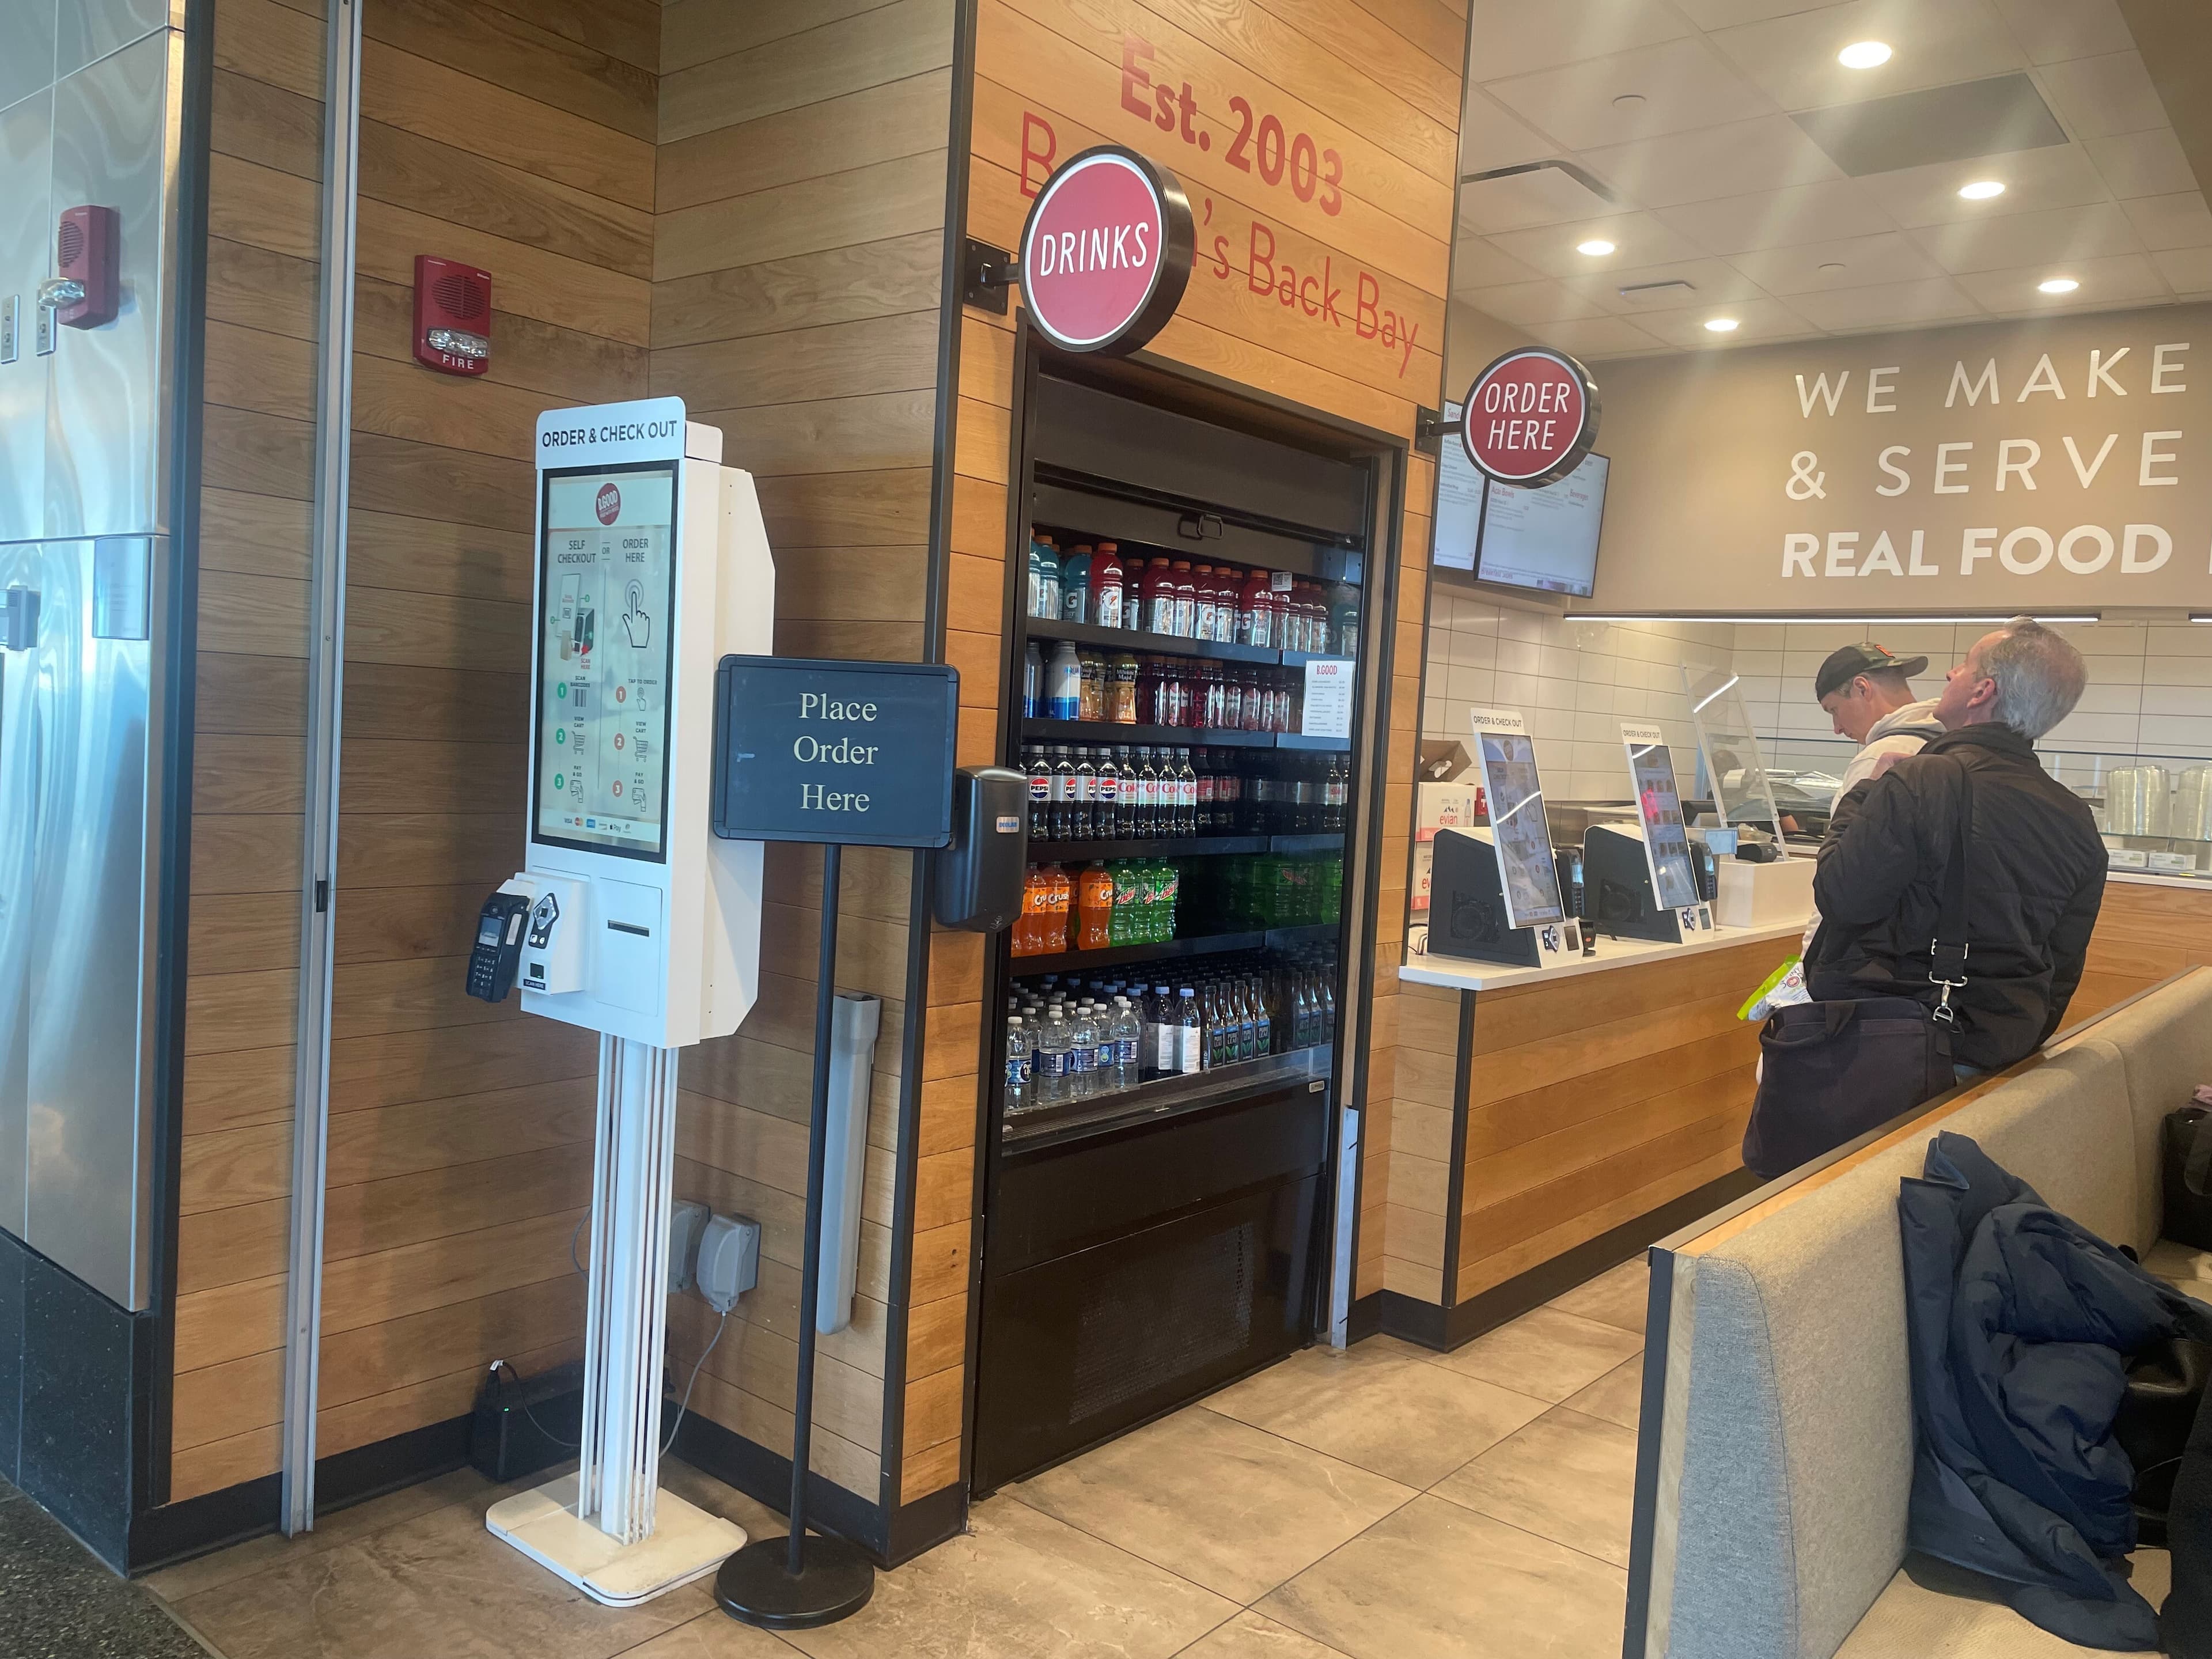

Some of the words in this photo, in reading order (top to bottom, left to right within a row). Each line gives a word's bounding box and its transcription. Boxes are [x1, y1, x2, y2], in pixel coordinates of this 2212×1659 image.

[1121, 32, 1211, 151] Est.
[1225, 96, 1344, 217] 2003
[1040, 221, 1149, 278] DRINKS
[1249, 221, 1340, 328] Back
[1356, 271, 1418, 378] Bay
[443, 355, 474, 369] FIRE
[1795, 366, 1900, 418] WE
[1945, 343, 2190, 408] MAKE
[1484, 382, 1571, 414] ORDER
[542, 429, 585, 448] ORDER
[589, 428, 597, 443] &
[600, 423, 645, 442] CHECK
[648, 420, 677, 439] OUT
[1487, 419, 1556, 450] HERE
[1786, 450, 1826, 501] &
[1875, 430, 2183, 497] SERVE
[569, 540, 585, 550] SELF
[623, 538, 649, 548] ORDER
[1782, 530, 1939, 578] REAL
[1960, 524, 2173, 575] FOOD
[558, 553, 596, 563] CHECKOUT
[625, 552, 645, 563] HERE
[1317, 665, 1337, 675] B.GOOD
[798, 693, 877, 722] Place
[1474, 715, 1490, 724] ORDER
[794, 736, 878, 765] Order
[800, 783, 870, 812] Here
[1184, 784, 1195, 794] Co
[1440, 815, 1457, 825] evian
[1034, 894, 1046, 906] Cru
[1048, 892, 1069, 904] Crush
[1100, 889, 1112, 900] Cru
